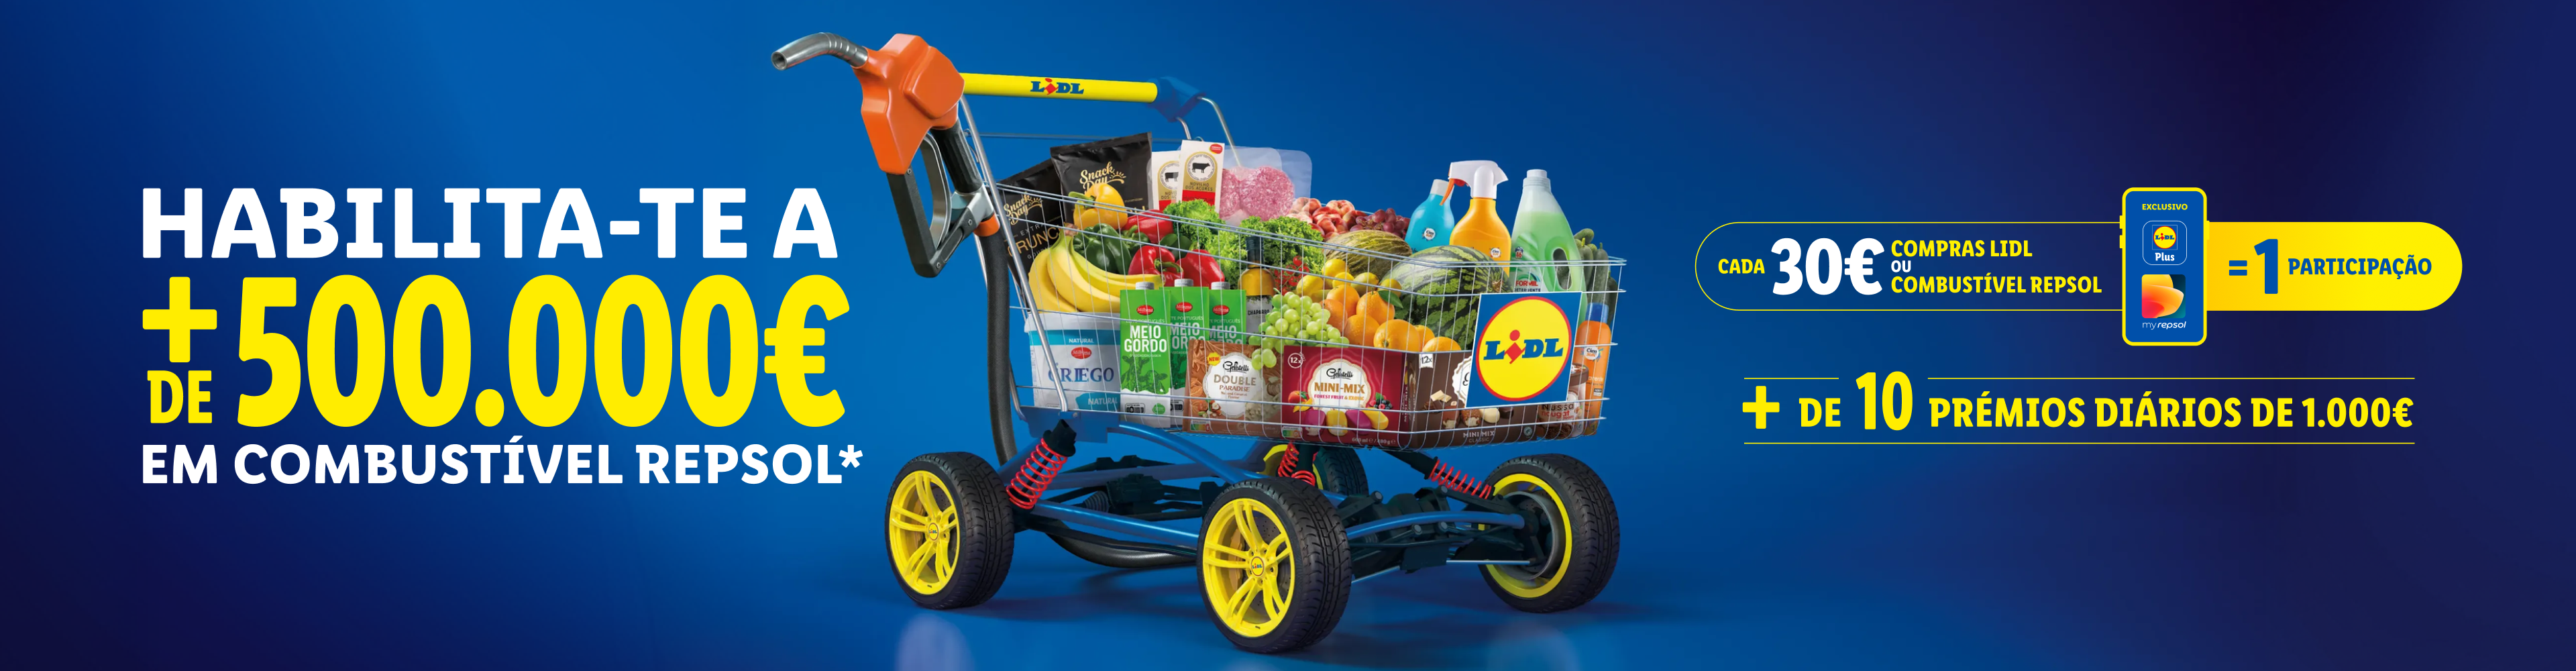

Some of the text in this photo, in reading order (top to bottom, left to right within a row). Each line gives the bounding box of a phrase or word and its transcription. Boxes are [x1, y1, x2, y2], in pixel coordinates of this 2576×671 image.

[1030, 77, 1085, 96] LIDL
[1079, 161, 1115, 185] Snack
[1004, 192, 1032, 217] Snack
[1008, 205, 1028, 225] Day
[1130, 325, 1161, 339] MEIO
[1170, 322, 1200, 336] MEIO
[1124, 338, 1167, 353] GORDO
[1483, 329, 1564, 364] LIDL
[1421, 356, 1433, 364] 12x
[1214, 374, 1256, 386] DOUBLE
[1219, 384, 1250, 393] PARADISE
[1313, 382, 1365, 394] MINI-MIX
[1542, 410, 1570, 419] nougat
